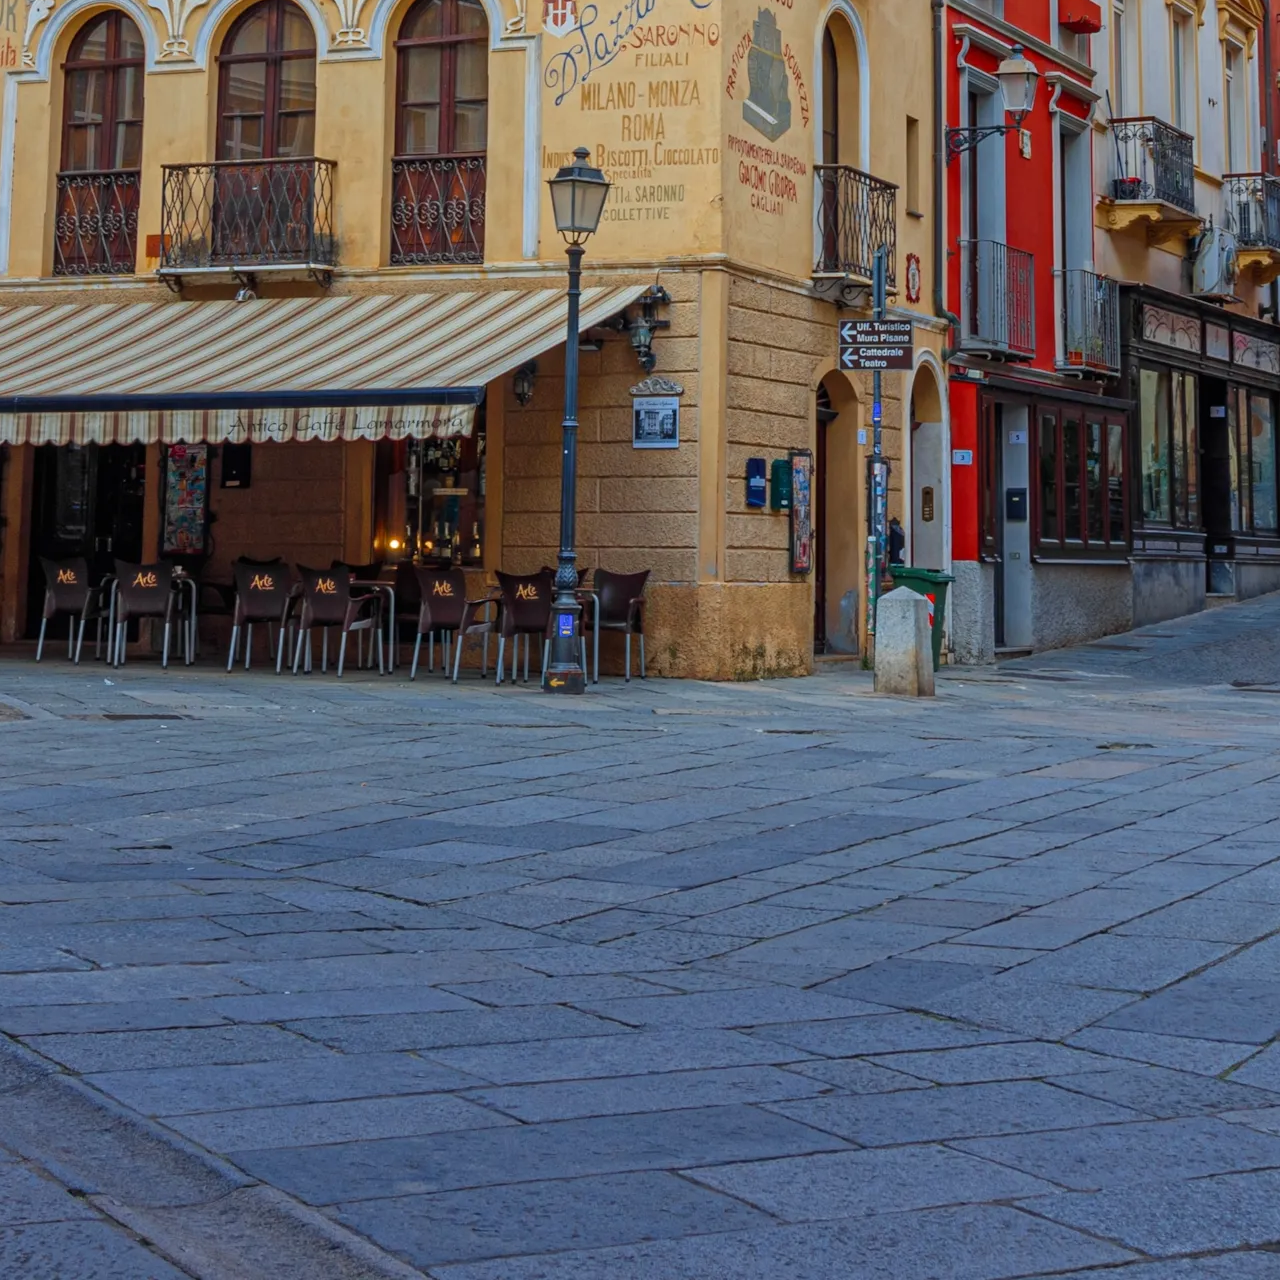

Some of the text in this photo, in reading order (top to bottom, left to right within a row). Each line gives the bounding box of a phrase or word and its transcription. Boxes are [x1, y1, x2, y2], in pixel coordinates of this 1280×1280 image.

[621, 22, 720, 52] SARONNO
[634, 52, 690, 67] FILIALI
[580, 80, 701, 111] MILANO MONZA
[621, 114, 666, 142] ROMA
[654, 141, 719, 167] CIOCCOLATO
[636, 185, 685, 203] SARONNO
[751, 193, 784, 217] CAGLIARI
[856, 322, 911, 332] Uff. Turistico
[856, 333, 910, 343] Mura Pisane
[859, 347, 904, 357] Cattedrale
[859, 358, 887, 368] Teatro
[227, 416, 288, 436] Antico
[352, 413, 464, 431] Lamarmora
[57, 569, 76, 583] Arte
[132, 572, 157, 587] Arte
[250, 574, 273, 589] Arte
[315, 577, 336, 593] Arte
[432, 580, 452, 596] Arte
[515, 584, 537, 599] Arte
